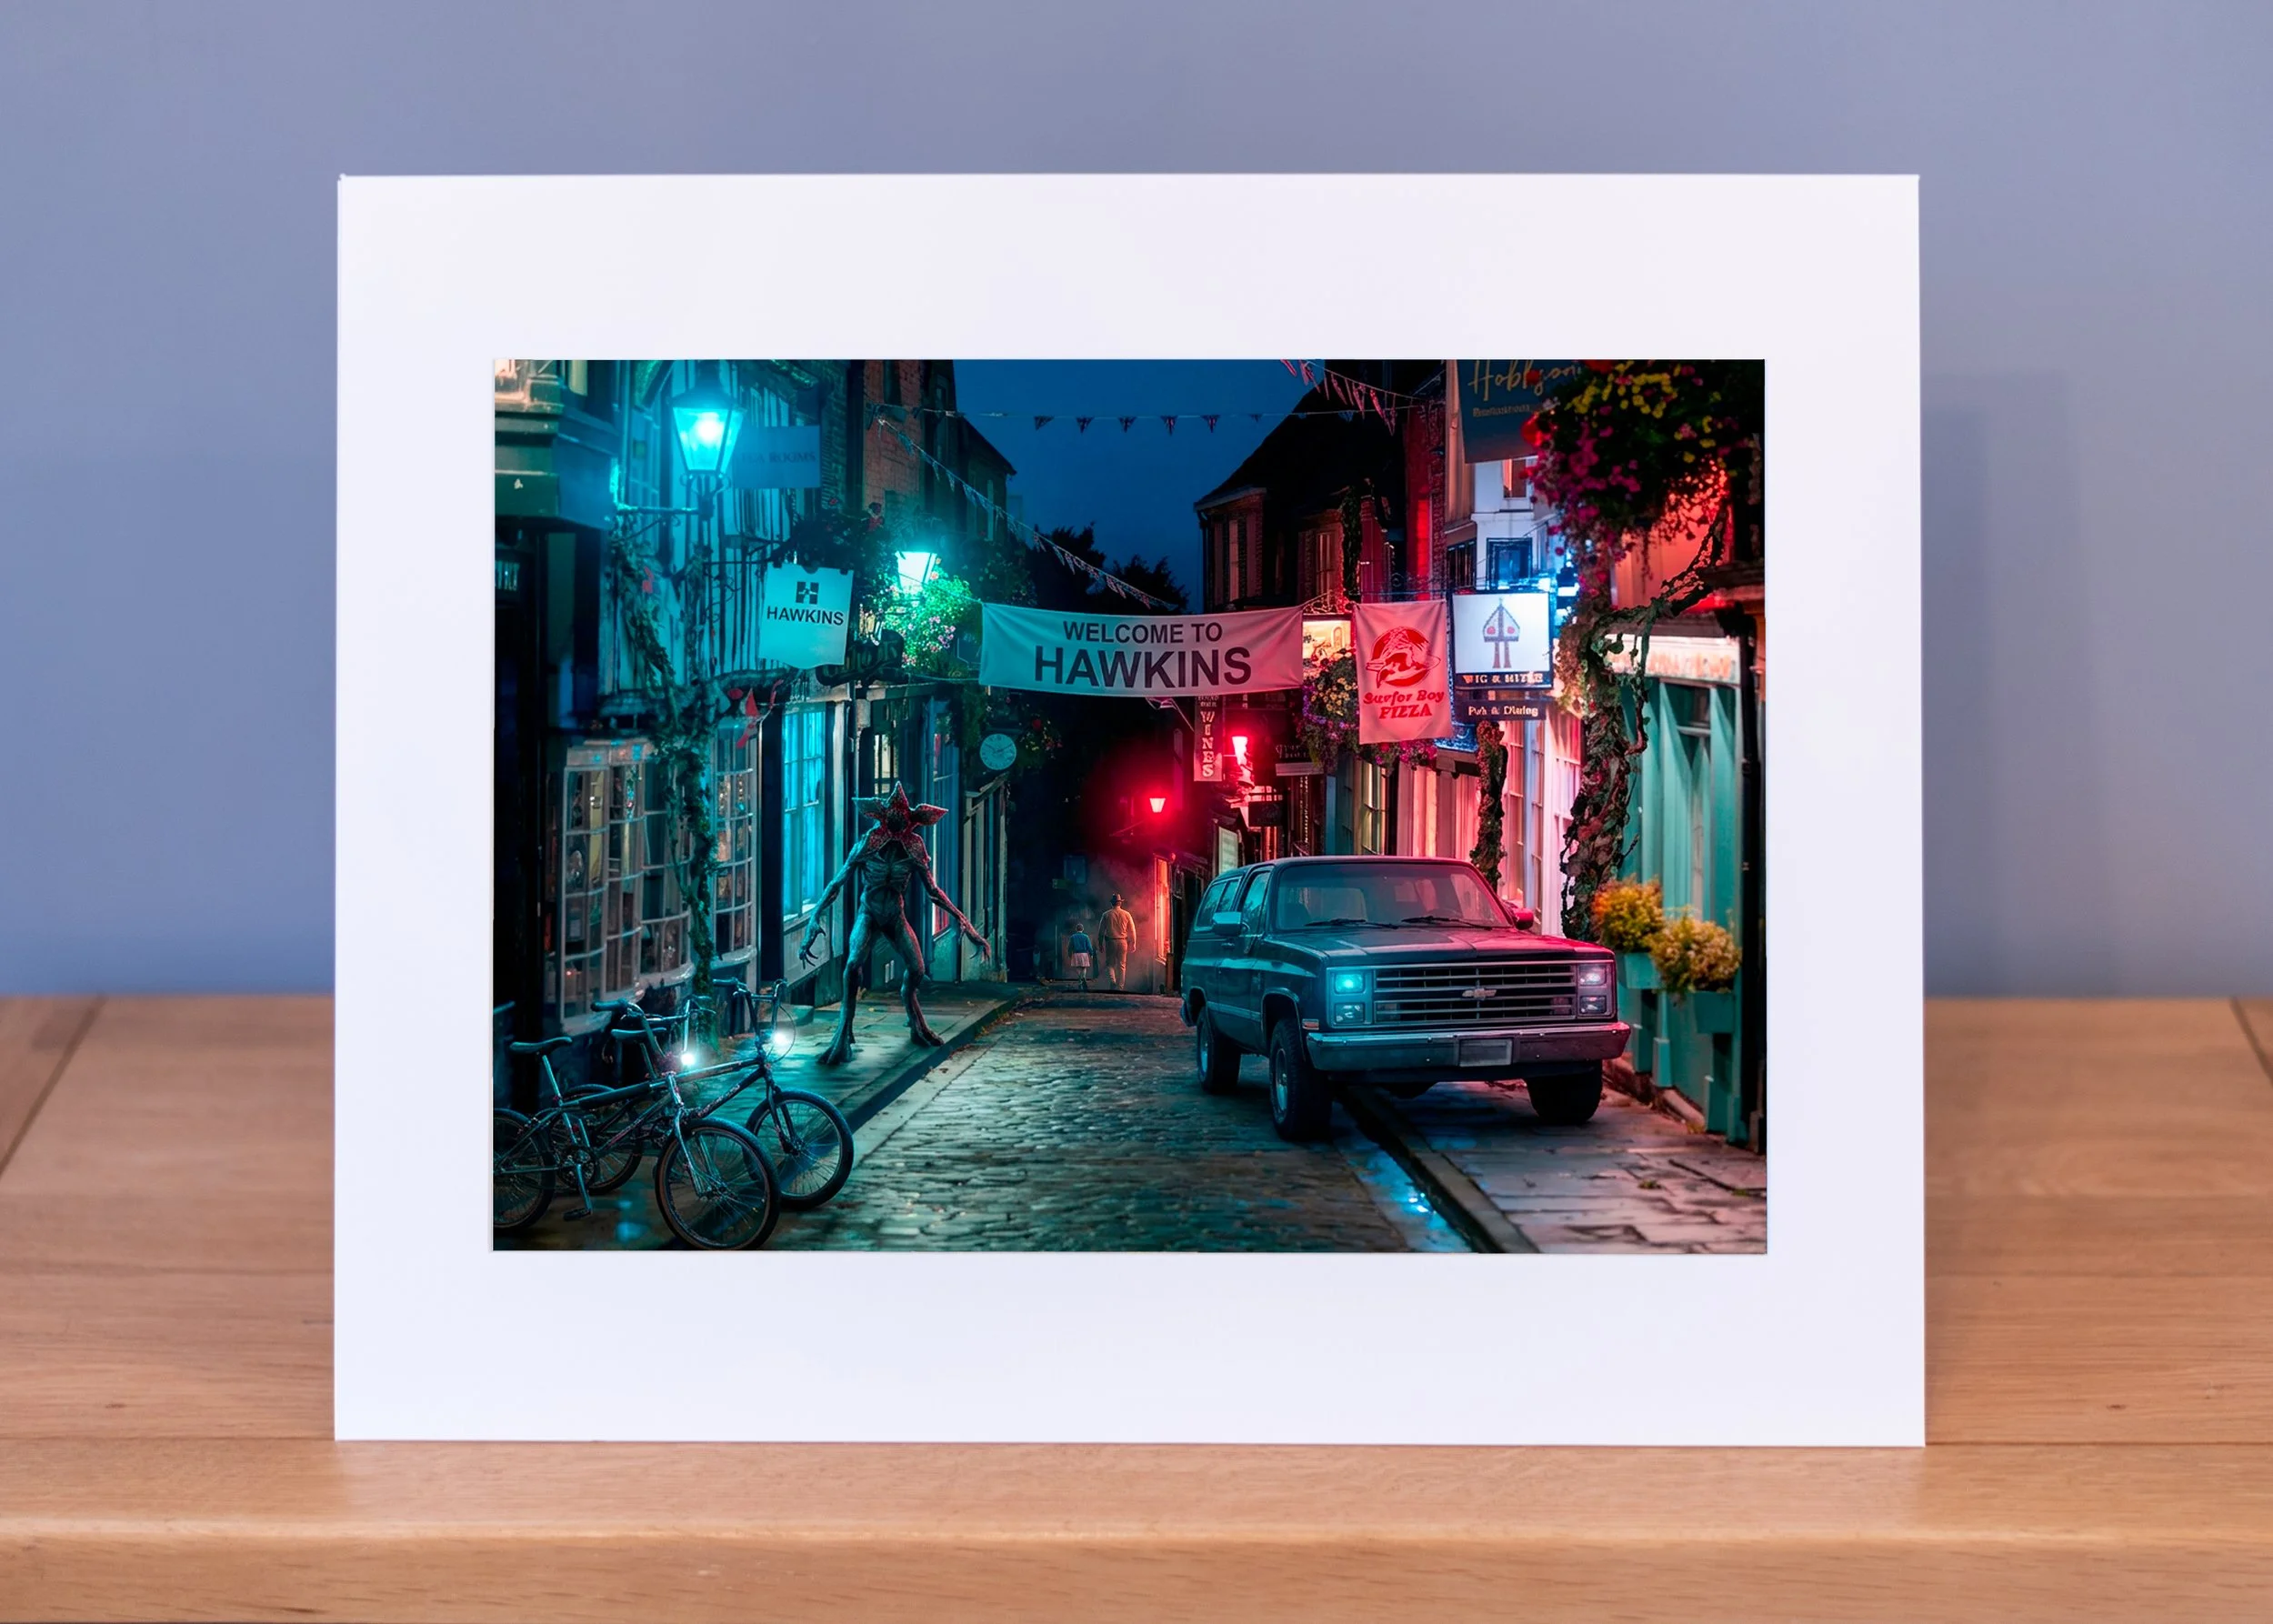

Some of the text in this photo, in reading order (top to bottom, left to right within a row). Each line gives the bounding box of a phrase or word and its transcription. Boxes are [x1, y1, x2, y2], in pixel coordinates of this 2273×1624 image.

[769, 451, 816, 464] ROOMS
[766, 606, 845, 627] HAWKINS
[1063, 620, 1223, 644] WELCOME TO
[1035, 645, 1252, 688] HAWKINS
[1462, 674, 1487, 684] WIG
[1417, 689, 1445, 703] Boy
[1378, 704, 1432, 719] PIZZA
[1504, 705, 1538, 717] Dining
[1200, 711, 1216, 777] WINES
